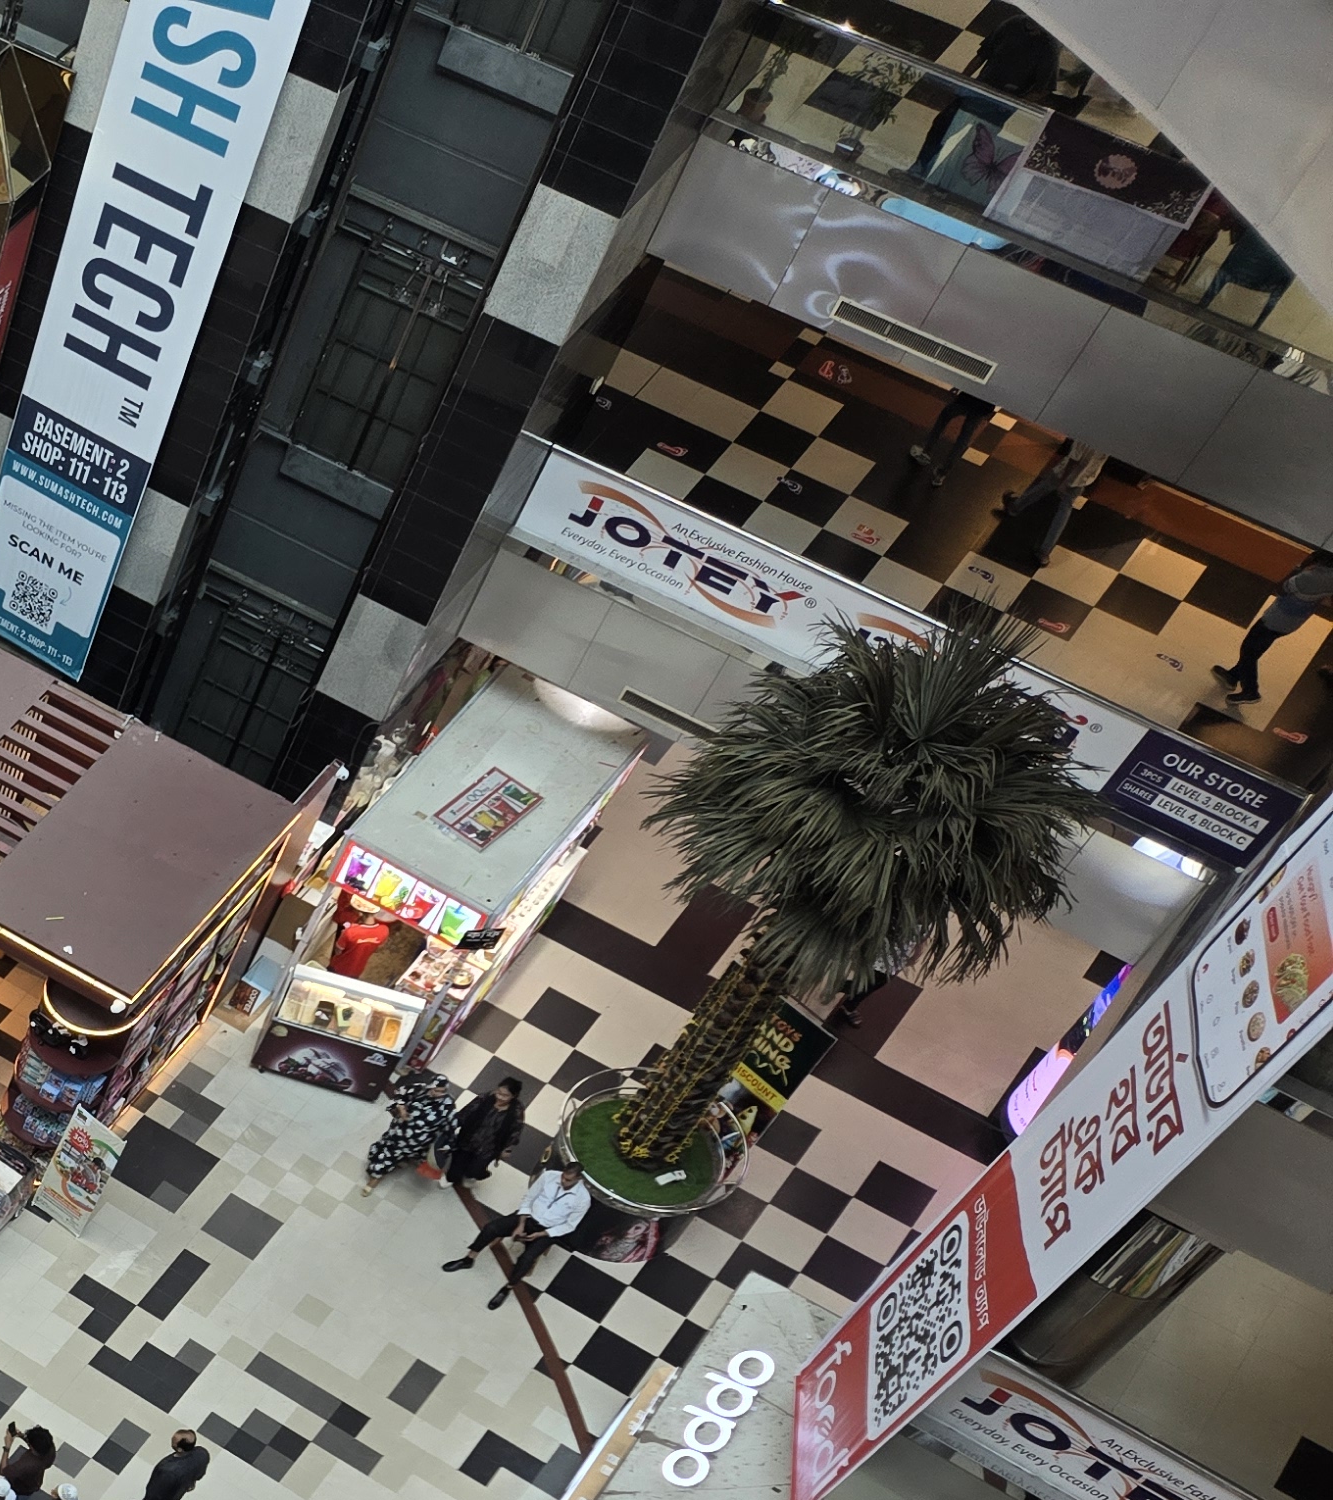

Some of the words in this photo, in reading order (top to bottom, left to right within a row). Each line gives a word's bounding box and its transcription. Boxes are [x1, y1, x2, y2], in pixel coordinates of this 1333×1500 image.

[63, 162, 214, 392] TECH
[22, 432, 66, 473] SHOP:
[69, 457, 89, 485] 111
[103, 476, 128, 504] 113
[34, 412, 116, 474] BASEMENT:
[116, 459, 130, 480] 2
[12, 460, 123, 529] WWW.SUMASHTECH.COM
[3, 499, 37, 525] MISSING
[38, 517, 54, 533] THE
[54, 526, 76, 544] ITEM
[75, 536, 107, 563] YOU'RE
[7, 534, 54, 569] SCAN
[58, 561, 85, 586] ME
[22, 521, 59, 548] LOOKING
[60, 541, 83, 560] FOR?
[561, 526, 608, 556] Everyday,
[608, 549, 637, 569] Every
[636, 561, 684, 590] Occasion
[568, 496, 806, 614] JOTEY
[671, 522, 689, 536] An
[688, 530, 736, 558] Exclusive
[734, 549, 778, 577] Fashion
[777, 569, 814, 593] House
[26, 633, 47, 652] SHOP:
[1123, 782, 1155, 802] SHAREE
[1157, 798, 1189, 819] LEVEL
[1198, 818, 1236, 842] BLOCK
[1236, 835, 1247, 846] C
[1140, 768, 1164, 784] 3PCS
[1170, 781, 1202, 802] LEVEL
[1213, 802, 1249, 825] BLOCK
[1249, 820, 1259, 829] A
[1162, 753, 1202, 780] OUR
[1204, 772, 1268, 809] STORE
[1142, 1000, 1189, 1158] অর্ডার
[1108, 1064, 1140, 1167] হবে
[1039, 1115, 1076, 1252] ট্যাপে
[1074, 1115, 1106, 1198] এক
[970, 1193, 988, 1289] ডাউনলোড
[977, 1288, 990, 1333] অ্যাপ
[661, 1350, 775, 1487] oppo
[948, 1408, 1011, 1446] Everyday,
[1011, 1442, 1049, 1470] Every
[1100, 1436, 1123, 1453] An
[1121, 1448, 1186, 1488] Exclusive
